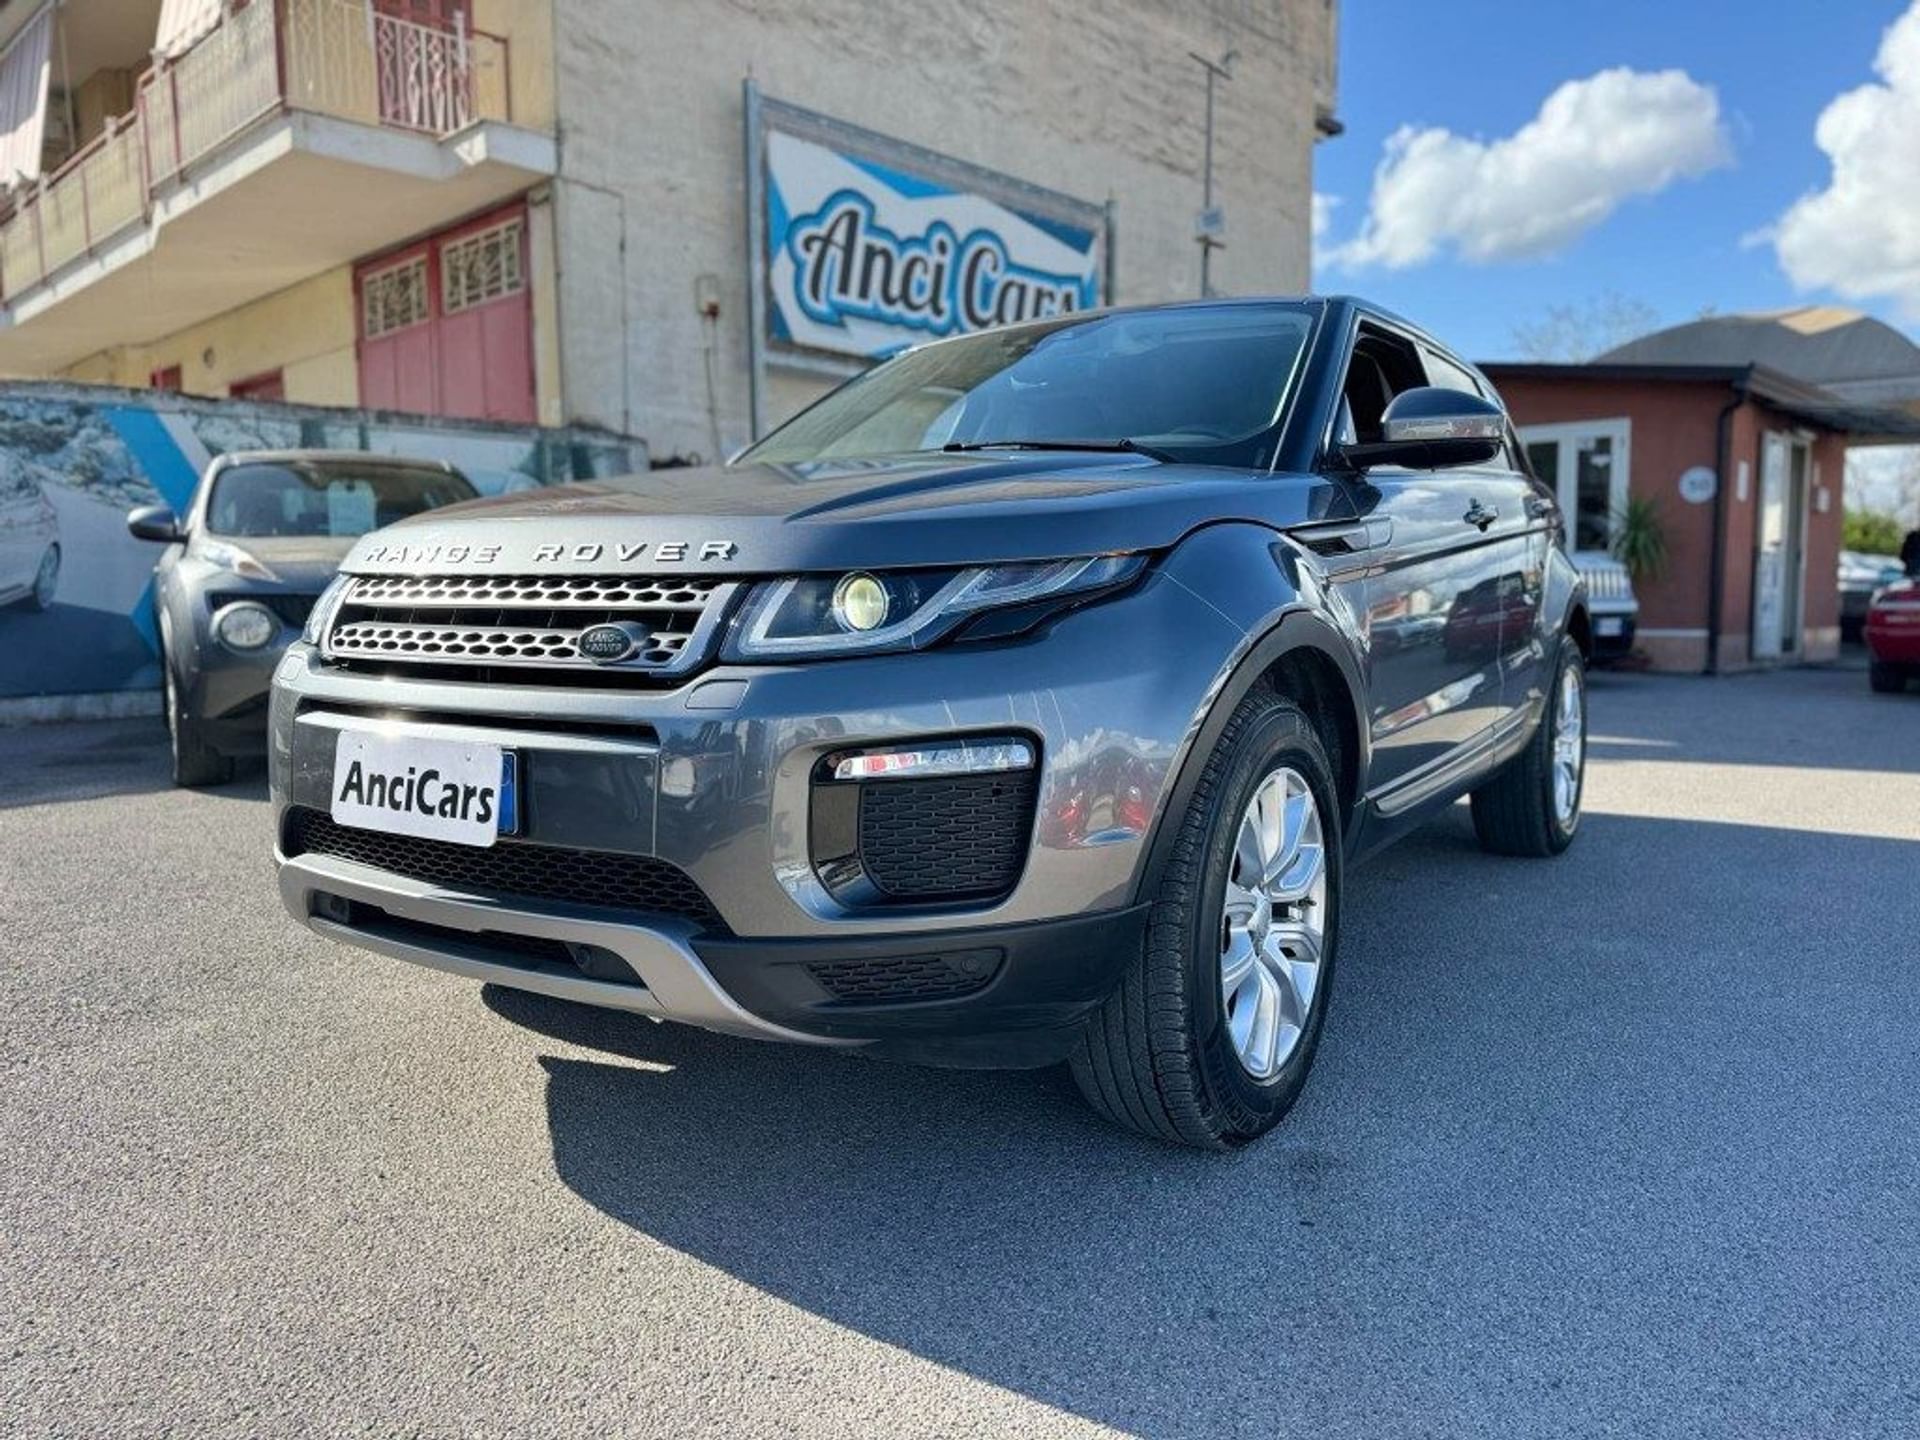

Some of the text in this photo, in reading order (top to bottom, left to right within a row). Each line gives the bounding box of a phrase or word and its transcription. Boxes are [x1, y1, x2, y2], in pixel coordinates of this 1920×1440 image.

[803, 209, 947, 317] Anci
[365, 540, 738, 564] RANGE ROVER
[339, 761, 494, 824] AnciCars
